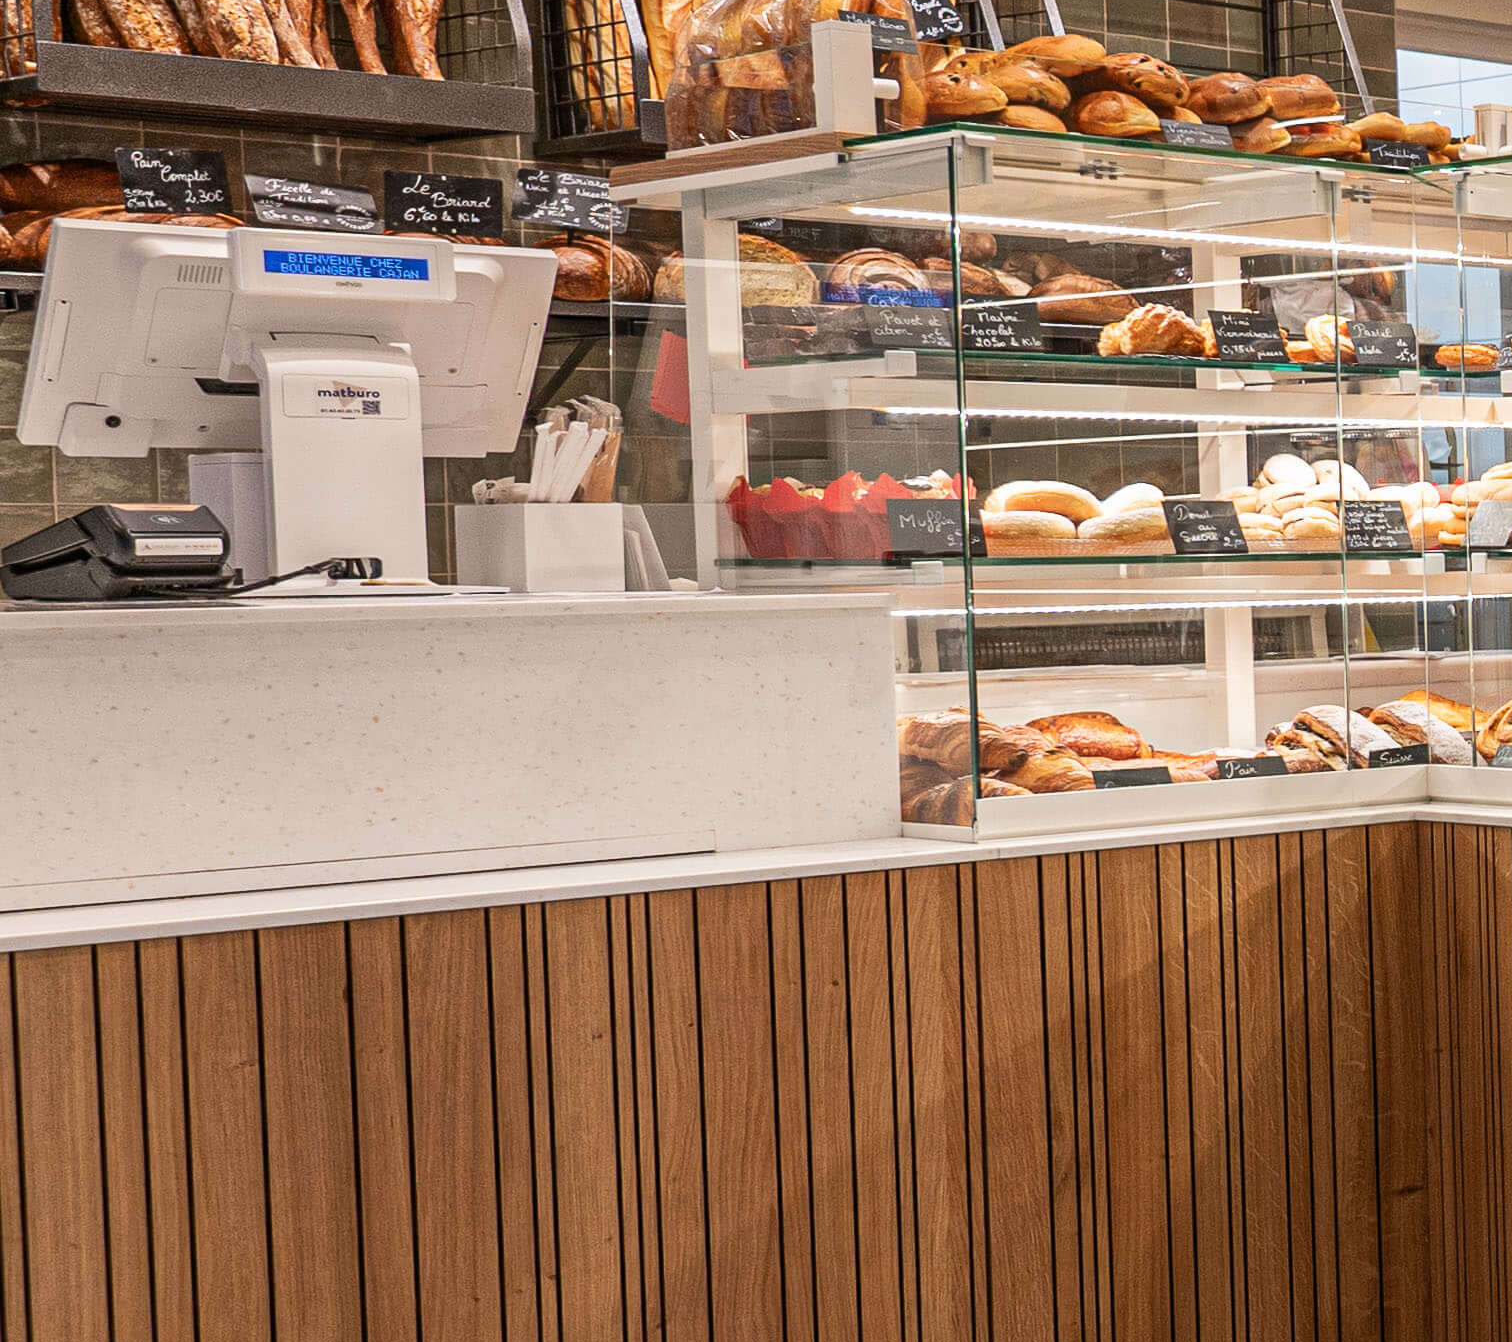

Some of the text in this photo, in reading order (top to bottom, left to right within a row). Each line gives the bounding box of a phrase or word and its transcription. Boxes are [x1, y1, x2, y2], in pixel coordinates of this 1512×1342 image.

[131, 151, 164, 168] Pain
[160, 164, 212, 188] Complet
[402, 175, 432, 194] Le
[527, 170, 551, 183] Le
[264, 178, 336, 196] Ficelle de
[430, 191, 492, 208] Briard
[288, 253, 403, 269] BIENVENUE CHEZ
[280, 263, 420, 279] BOULANGERIE CAJAN
[963, 325, 1015, 337] Chocolat
[317, 387, 381, 399] matburo
[899, 509, 955, 533] Muffin
